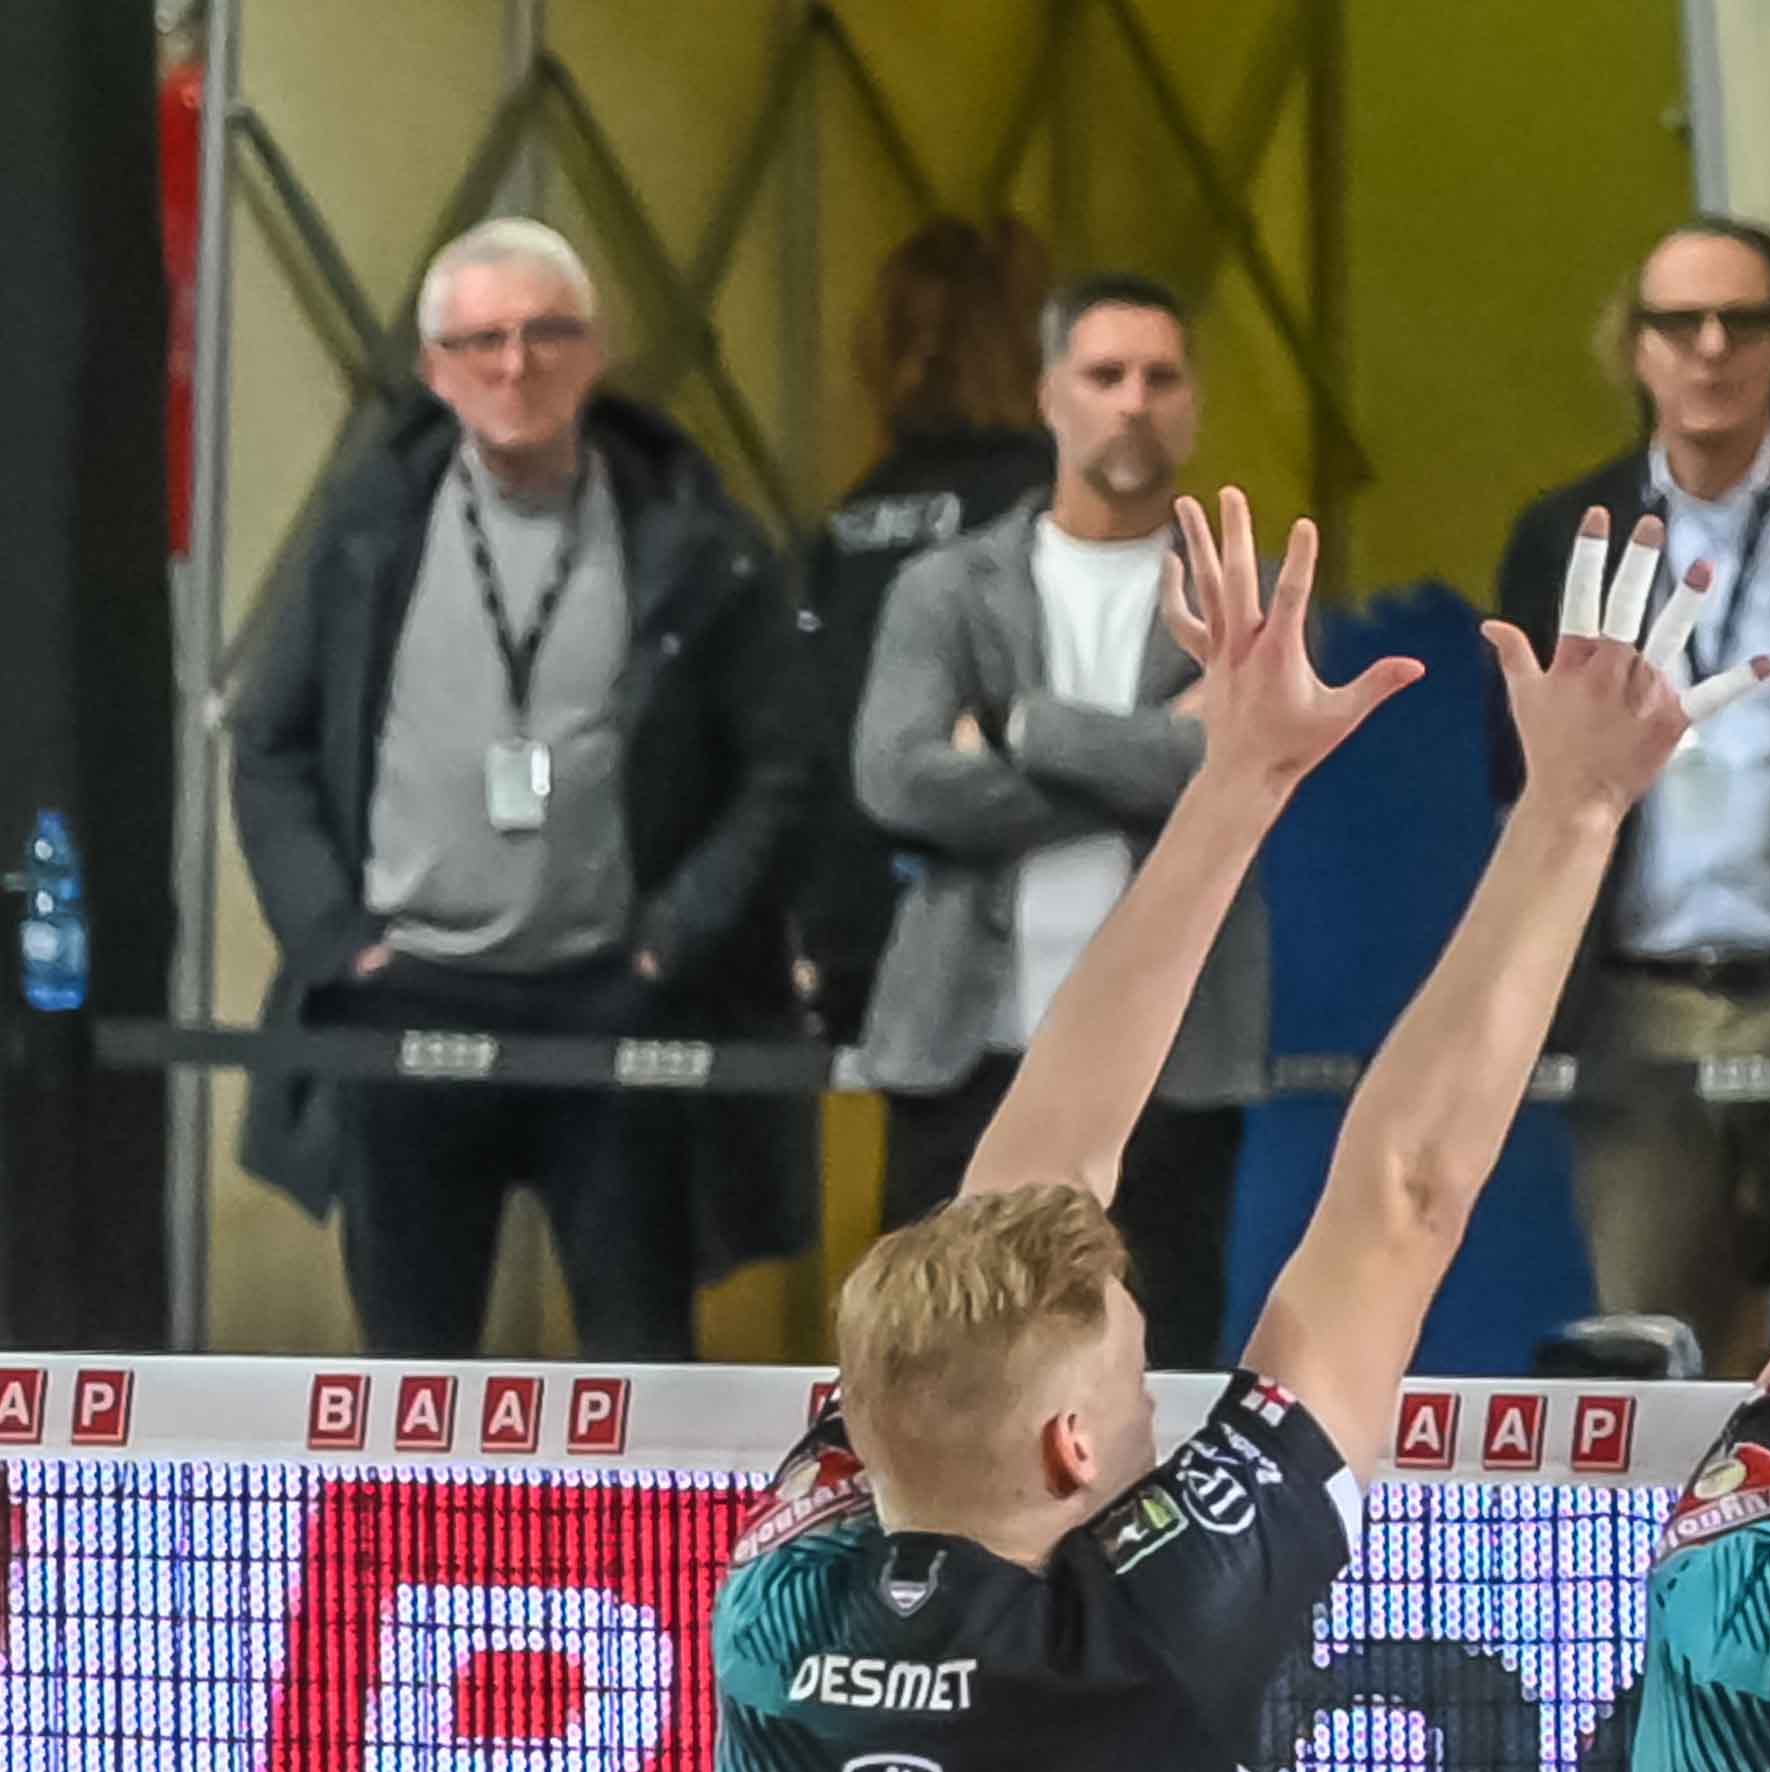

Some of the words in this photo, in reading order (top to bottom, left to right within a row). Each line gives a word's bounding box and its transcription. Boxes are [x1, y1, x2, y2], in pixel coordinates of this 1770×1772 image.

[314, 1380, 620, 1444] BAAP
[1400, 1401, 1627, 1462] AAP
[789, 1654, 977, 1709] DESMET
